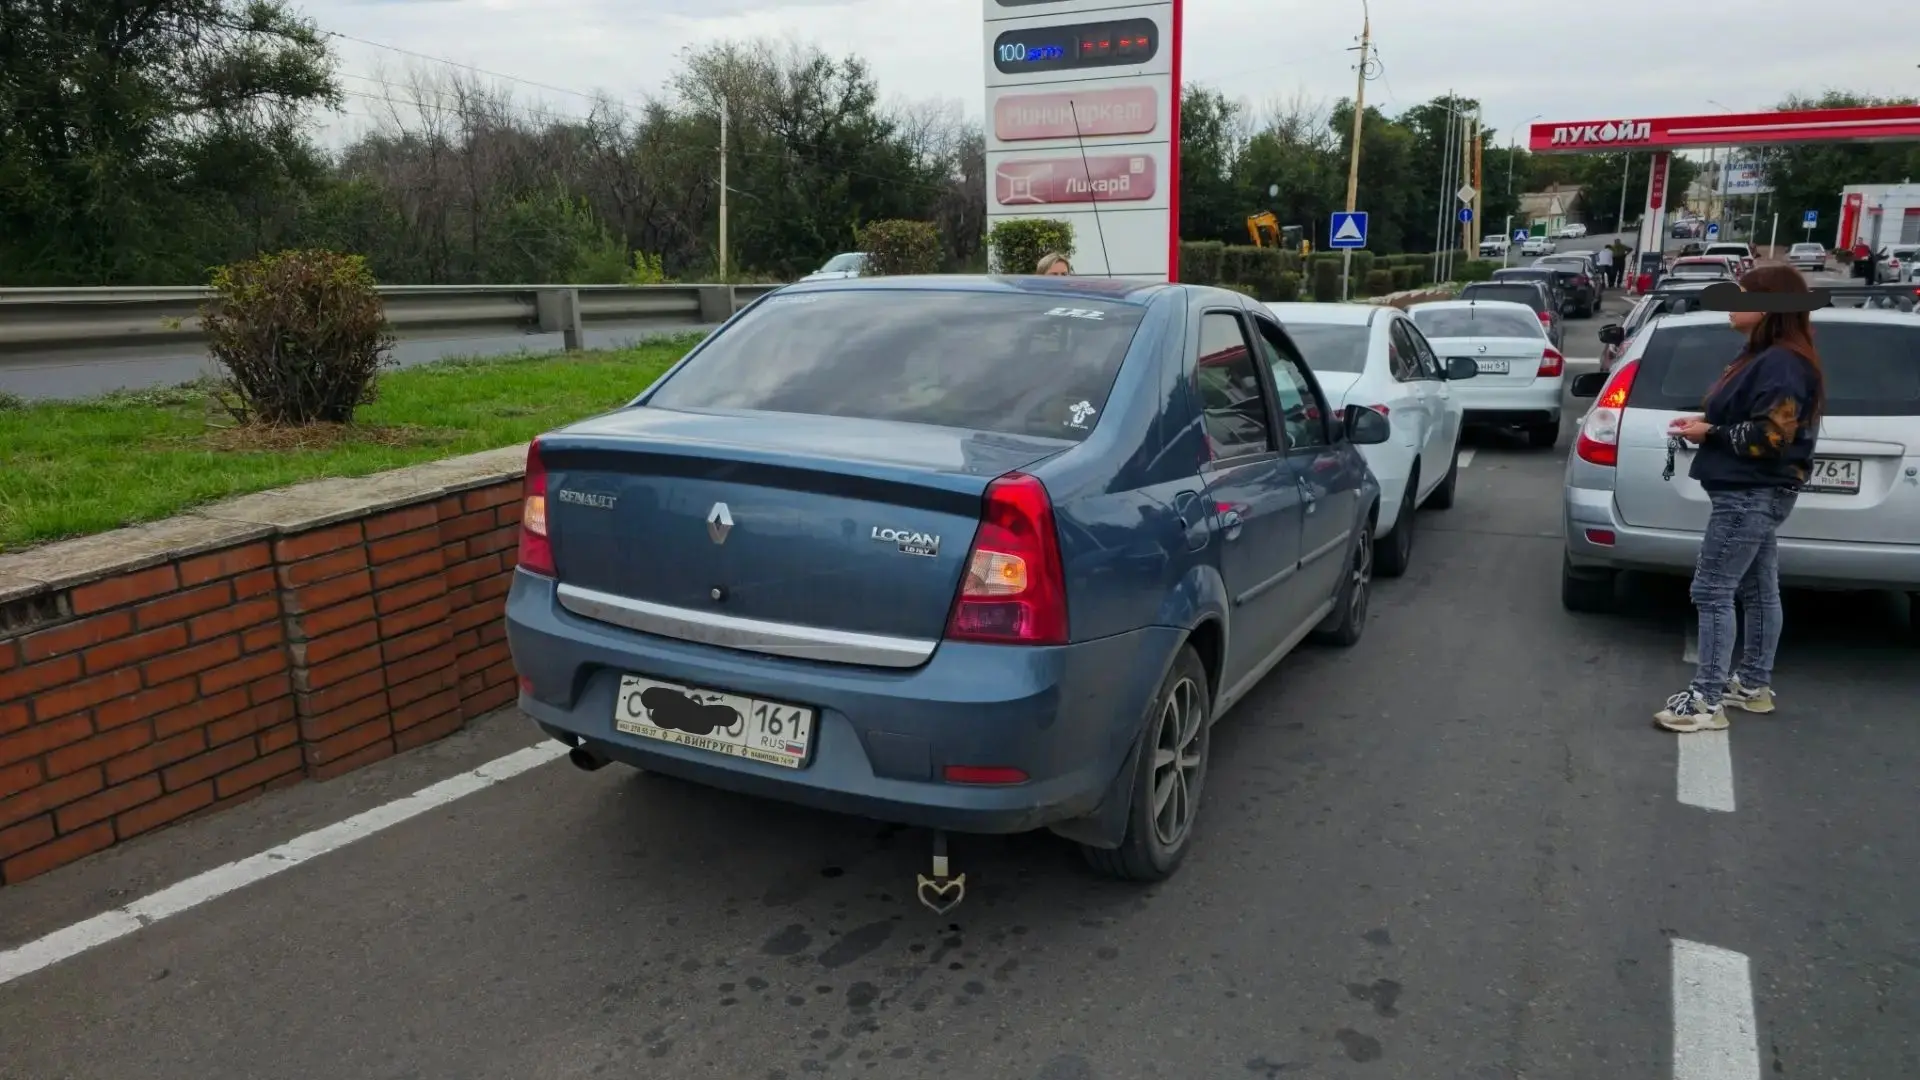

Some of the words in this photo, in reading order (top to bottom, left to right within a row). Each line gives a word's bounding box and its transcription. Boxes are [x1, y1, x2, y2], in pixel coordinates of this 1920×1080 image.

[999, 43, 1025, 62] 100
[1551, 119, 1652, 144] ЛУКОЙЛ
[1814, 461, 1852, 478] 761
[559, 489, 617, 509] RENAULT
[871, 526, 940, 547] LOGAN
[755, 703, 802, 740] 161
[675, 733, 734, 754] АВИНГРУП
[760, 736, 785, 750] RUS
